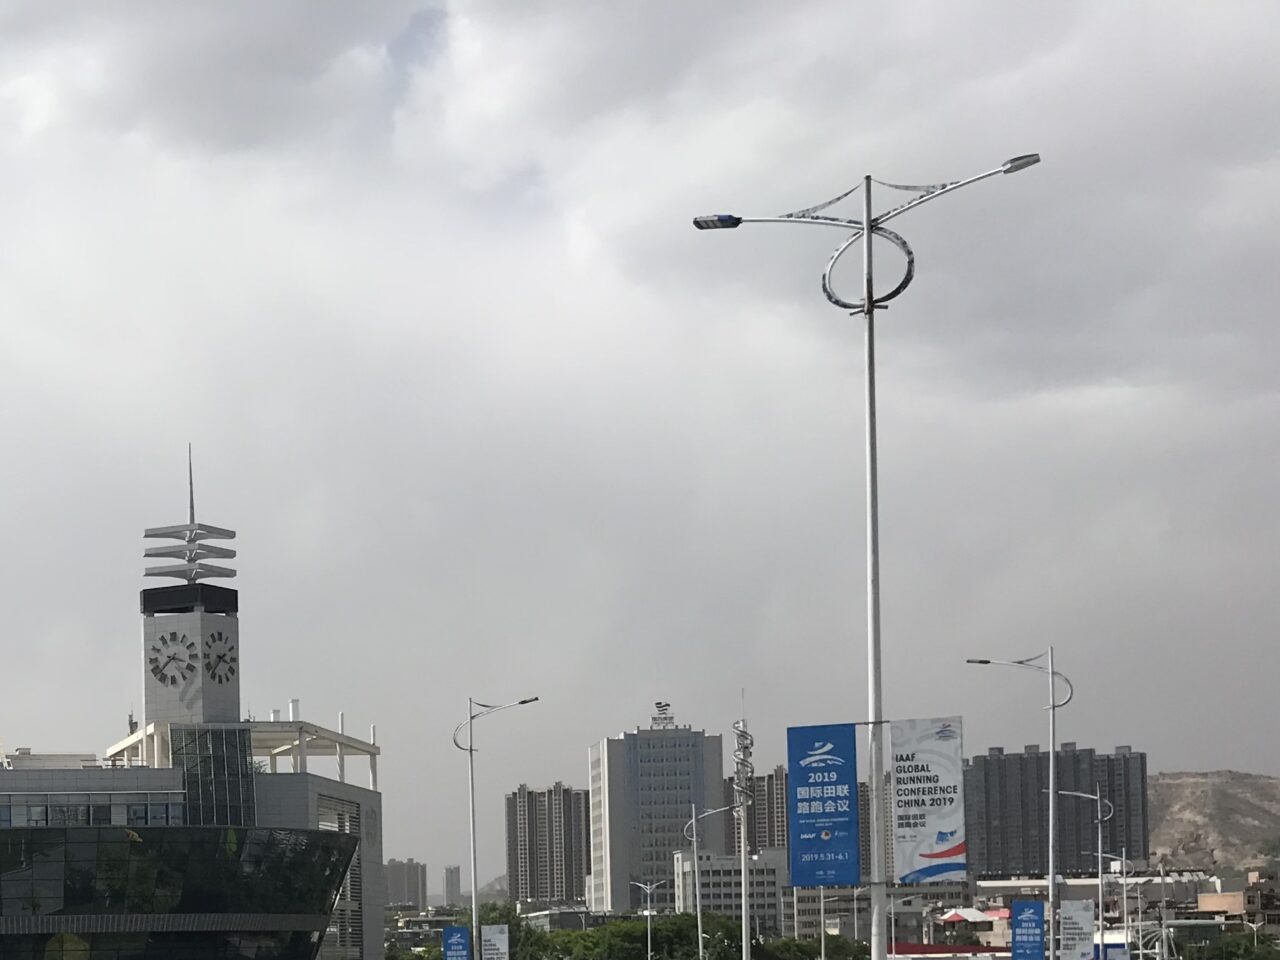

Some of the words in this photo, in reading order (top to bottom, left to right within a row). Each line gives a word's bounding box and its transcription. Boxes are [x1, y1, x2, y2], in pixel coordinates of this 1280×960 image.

[895, 753, 916, 763] IAAF
[895, 764, 932, 774] GLOBAL
[807, 772, 837, 783] 2019
[896, 775, 940, 785] RUNNING
[796, 785, 850, 799] 国际田联
[896, 785, 959, 797] CONFERENCE
[797, 800, 850, 815] 路跑会议
[897, 798, 927, 809] CHINA
[929, 797, 955, 807] 2019
